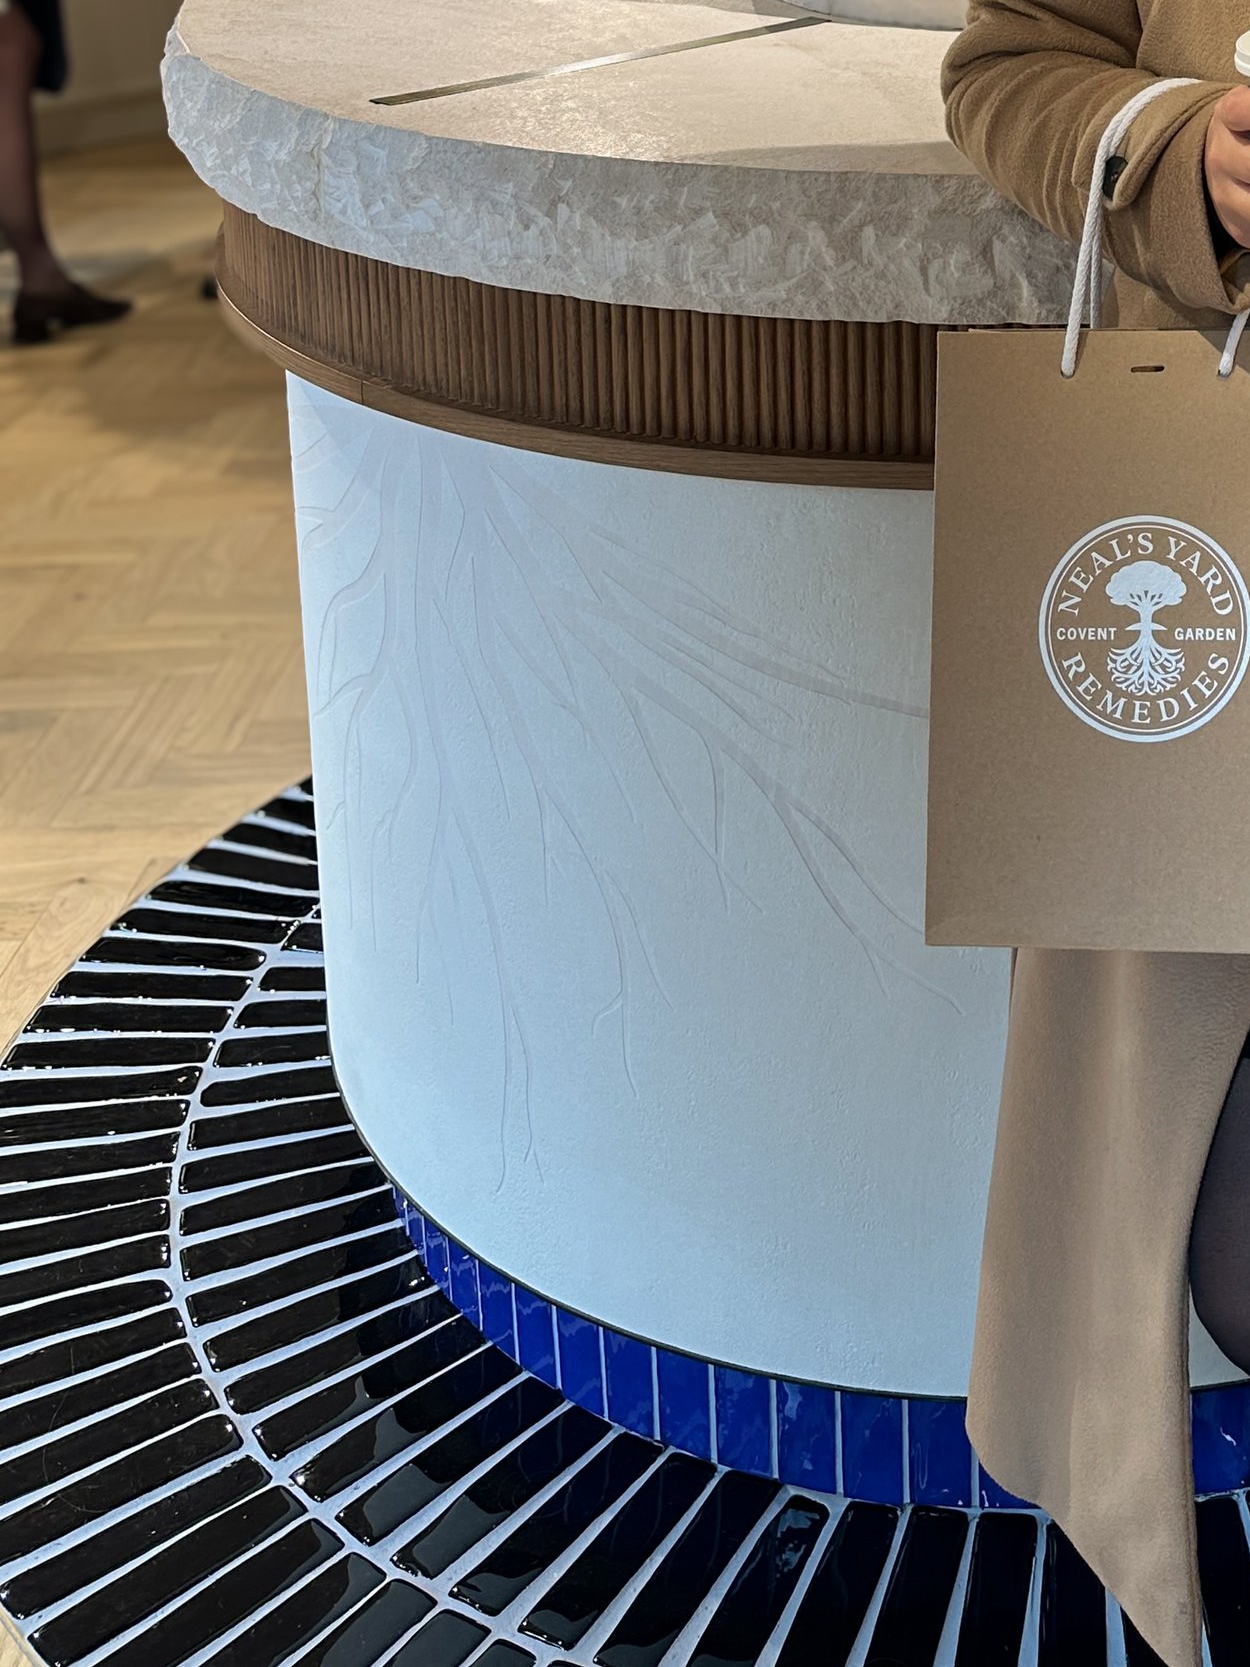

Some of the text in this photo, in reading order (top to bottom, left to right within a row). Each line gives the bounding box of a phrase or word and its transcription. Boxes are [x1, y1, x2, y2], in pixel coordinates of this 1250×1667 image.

[1058, 532, 1234, 617] NEAL'S YARD
[1056, 627, 1236, 641] COVENT GARDEN
[1062, 652, 1229, 724] REMEDIES
